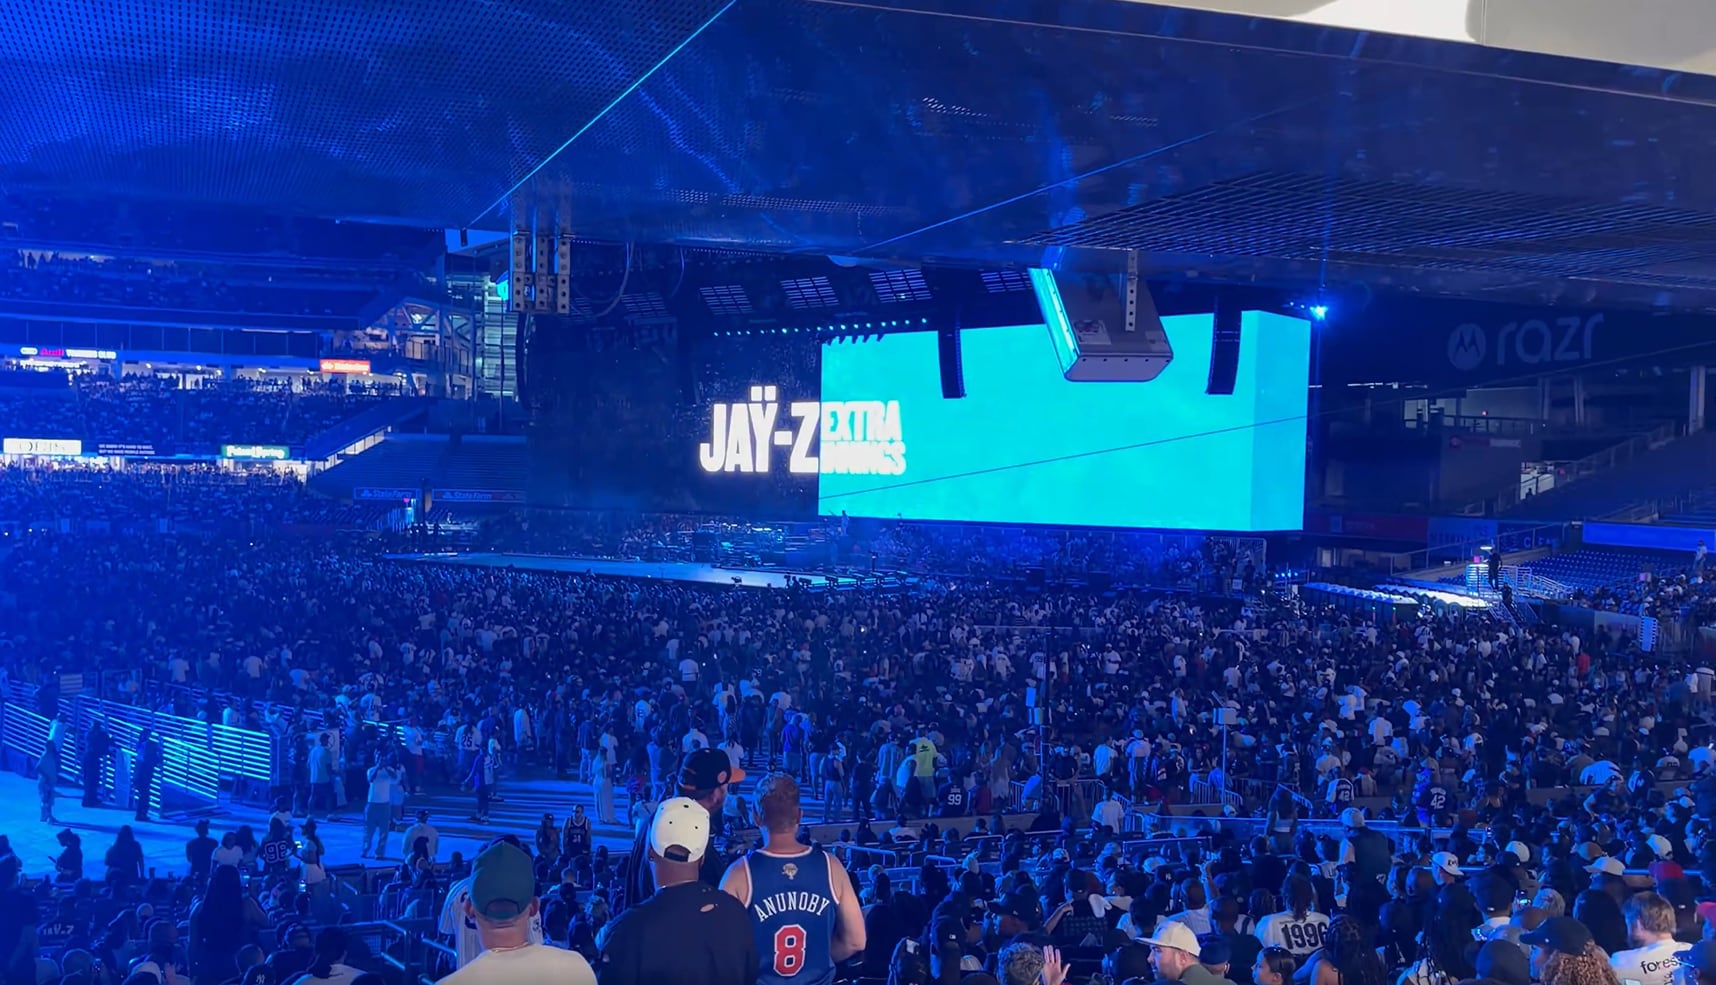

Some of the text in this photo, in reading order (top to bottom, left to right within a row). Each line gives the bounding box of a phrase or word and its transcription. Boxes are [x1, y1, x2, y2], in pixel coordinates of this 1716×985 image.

[1497, 312, 1604, 365] razr
[821, 400, 903, 441] EXTRA
[947, 793, 962, 806] 99
[1429, 795, 1447, 810] 42
[754, 891, 830, 922] ANUNOBY
[773, 924, 807, 977] 8
[1281, 922, 1328, 950] 1996
[1640, 957, 1680, 975] fores
